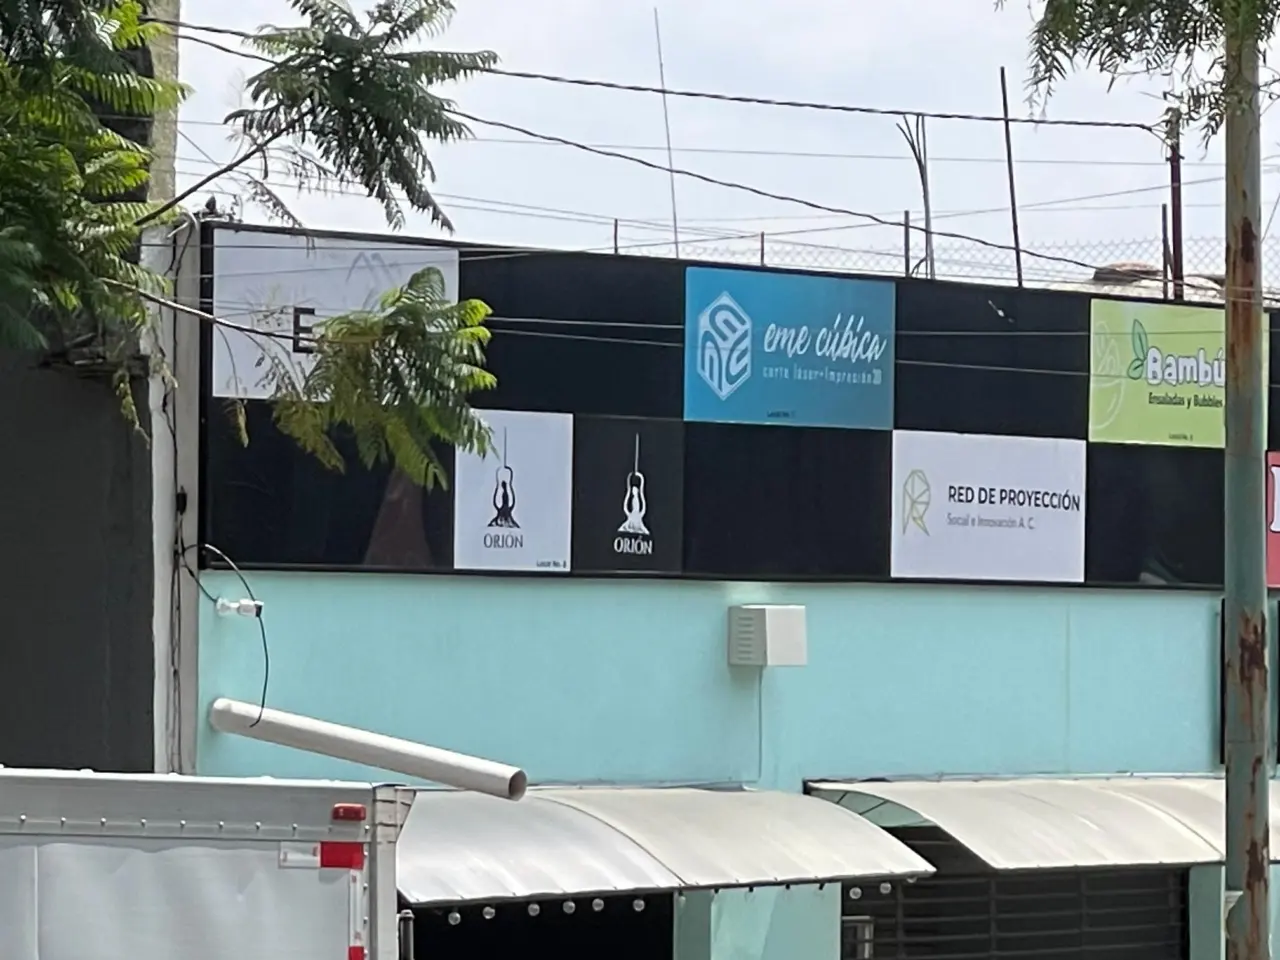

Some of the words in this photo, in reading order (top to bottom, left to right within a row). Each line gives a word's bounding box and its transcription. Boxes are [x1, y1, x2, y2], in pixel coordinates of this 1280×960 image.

[763, 323, 811, 358] eme
[815, 312, 887, 363] cúbica
[1146, 346, 1226, 388] Bambú
[1186, 397, 1192, 409] y
[949, 485, 975, 504] RED
[978, 487, 997, 505] DE
[1000, 489, 1081, 511] PROYECCIÓN
[947, 513, 970, 526] Social
[483, 532, 524, 549] ORIÓN
[614, 535, 653, 555] ORIÓN
